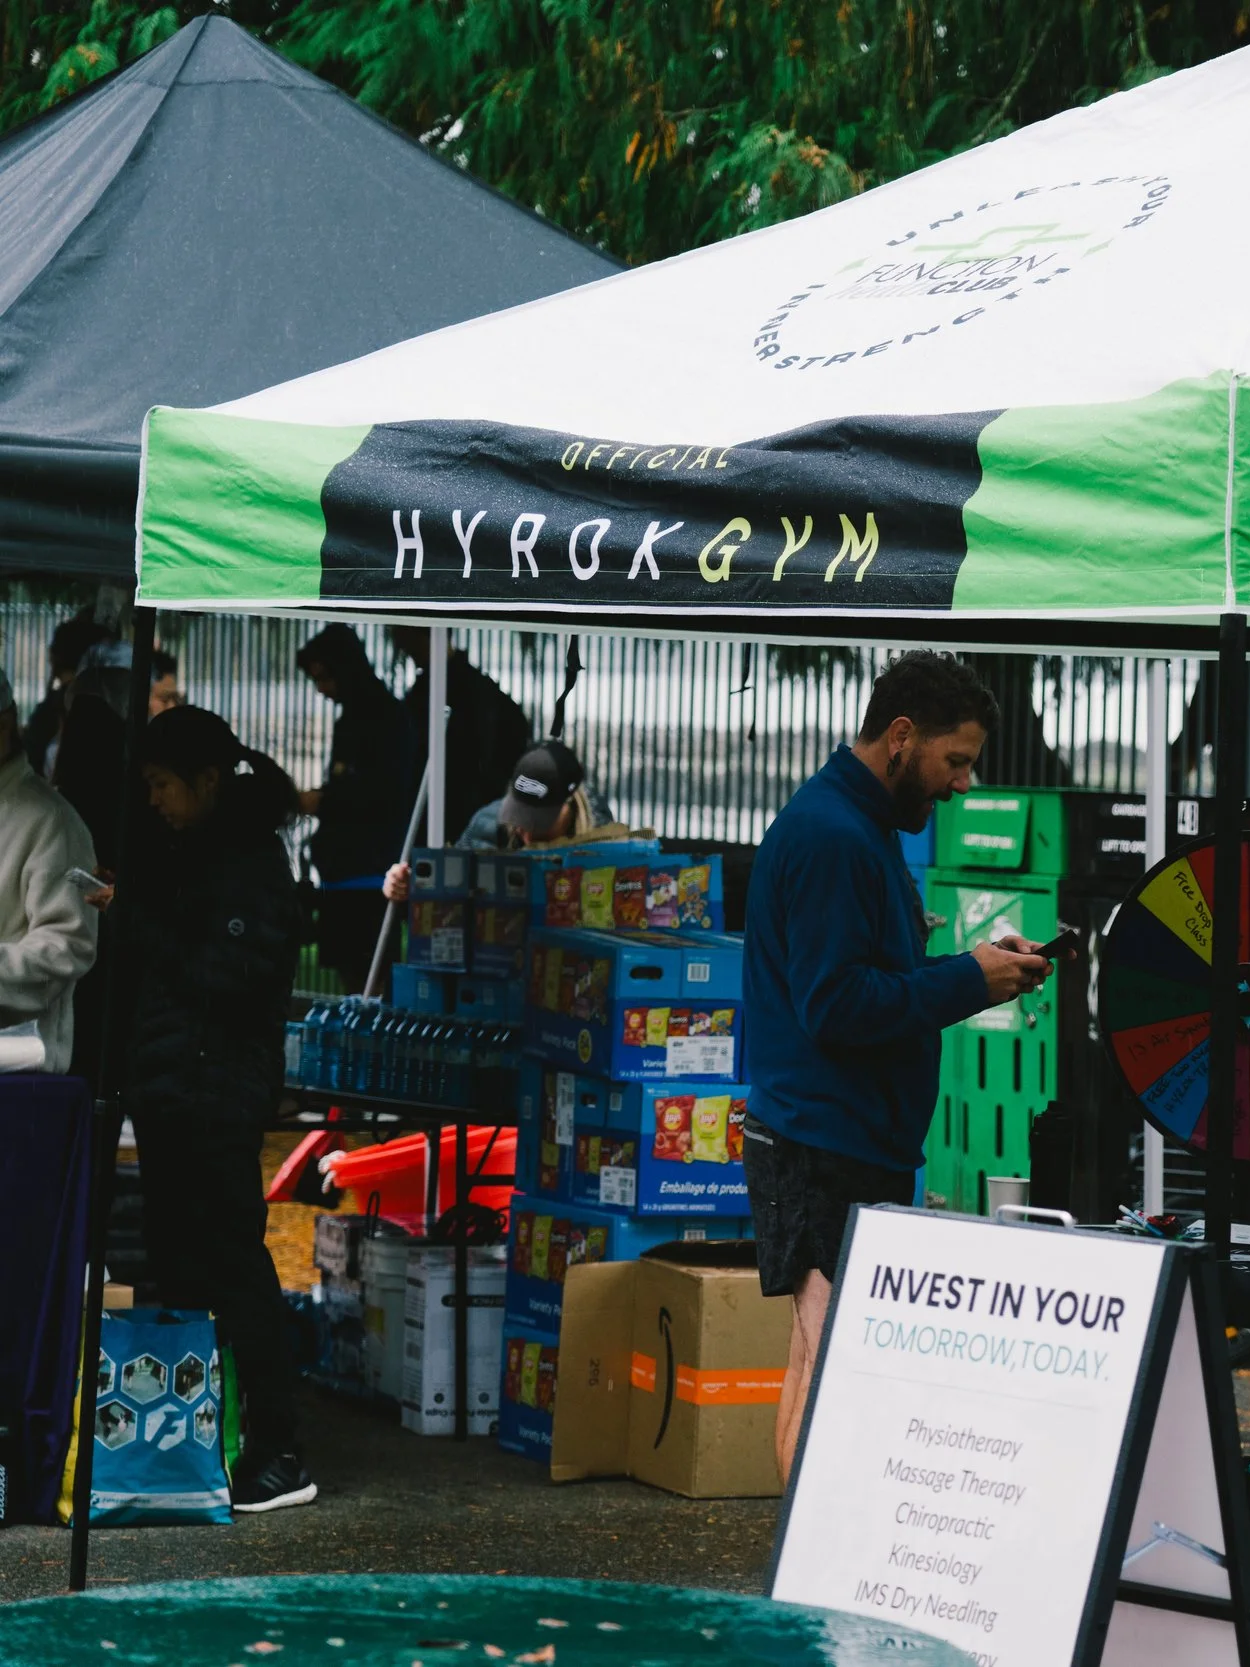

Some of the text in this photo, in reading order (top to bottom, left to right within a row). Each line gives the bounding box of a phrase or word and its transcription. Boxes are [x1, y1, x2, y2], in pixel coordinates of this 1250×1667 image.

[855, 251, 1060, 284] FUNCTION
[926, 274, 1019, 297] CLUB
[560, 440, 733, 472] OFFICIAL
[697, 516, 881, 584] GYM
[1173, 871, 1211, 929] Free Drop
[1185, 918, 1206, 947] Class
[706, 1181, 719, 1193] de
[869, 1264, 1126, 1333] INVEST IN YOUR
[905, 1417, 1023, 1462] Physiotherapy
[883, 1457, 1027, 1506] Massage Therapy
[895, 1502, 996, 1542] Chiropractic
[888, 1543, 984, 1587] Kinesiology
[854, 1580, 999, 1634] IMS Dry Needling
